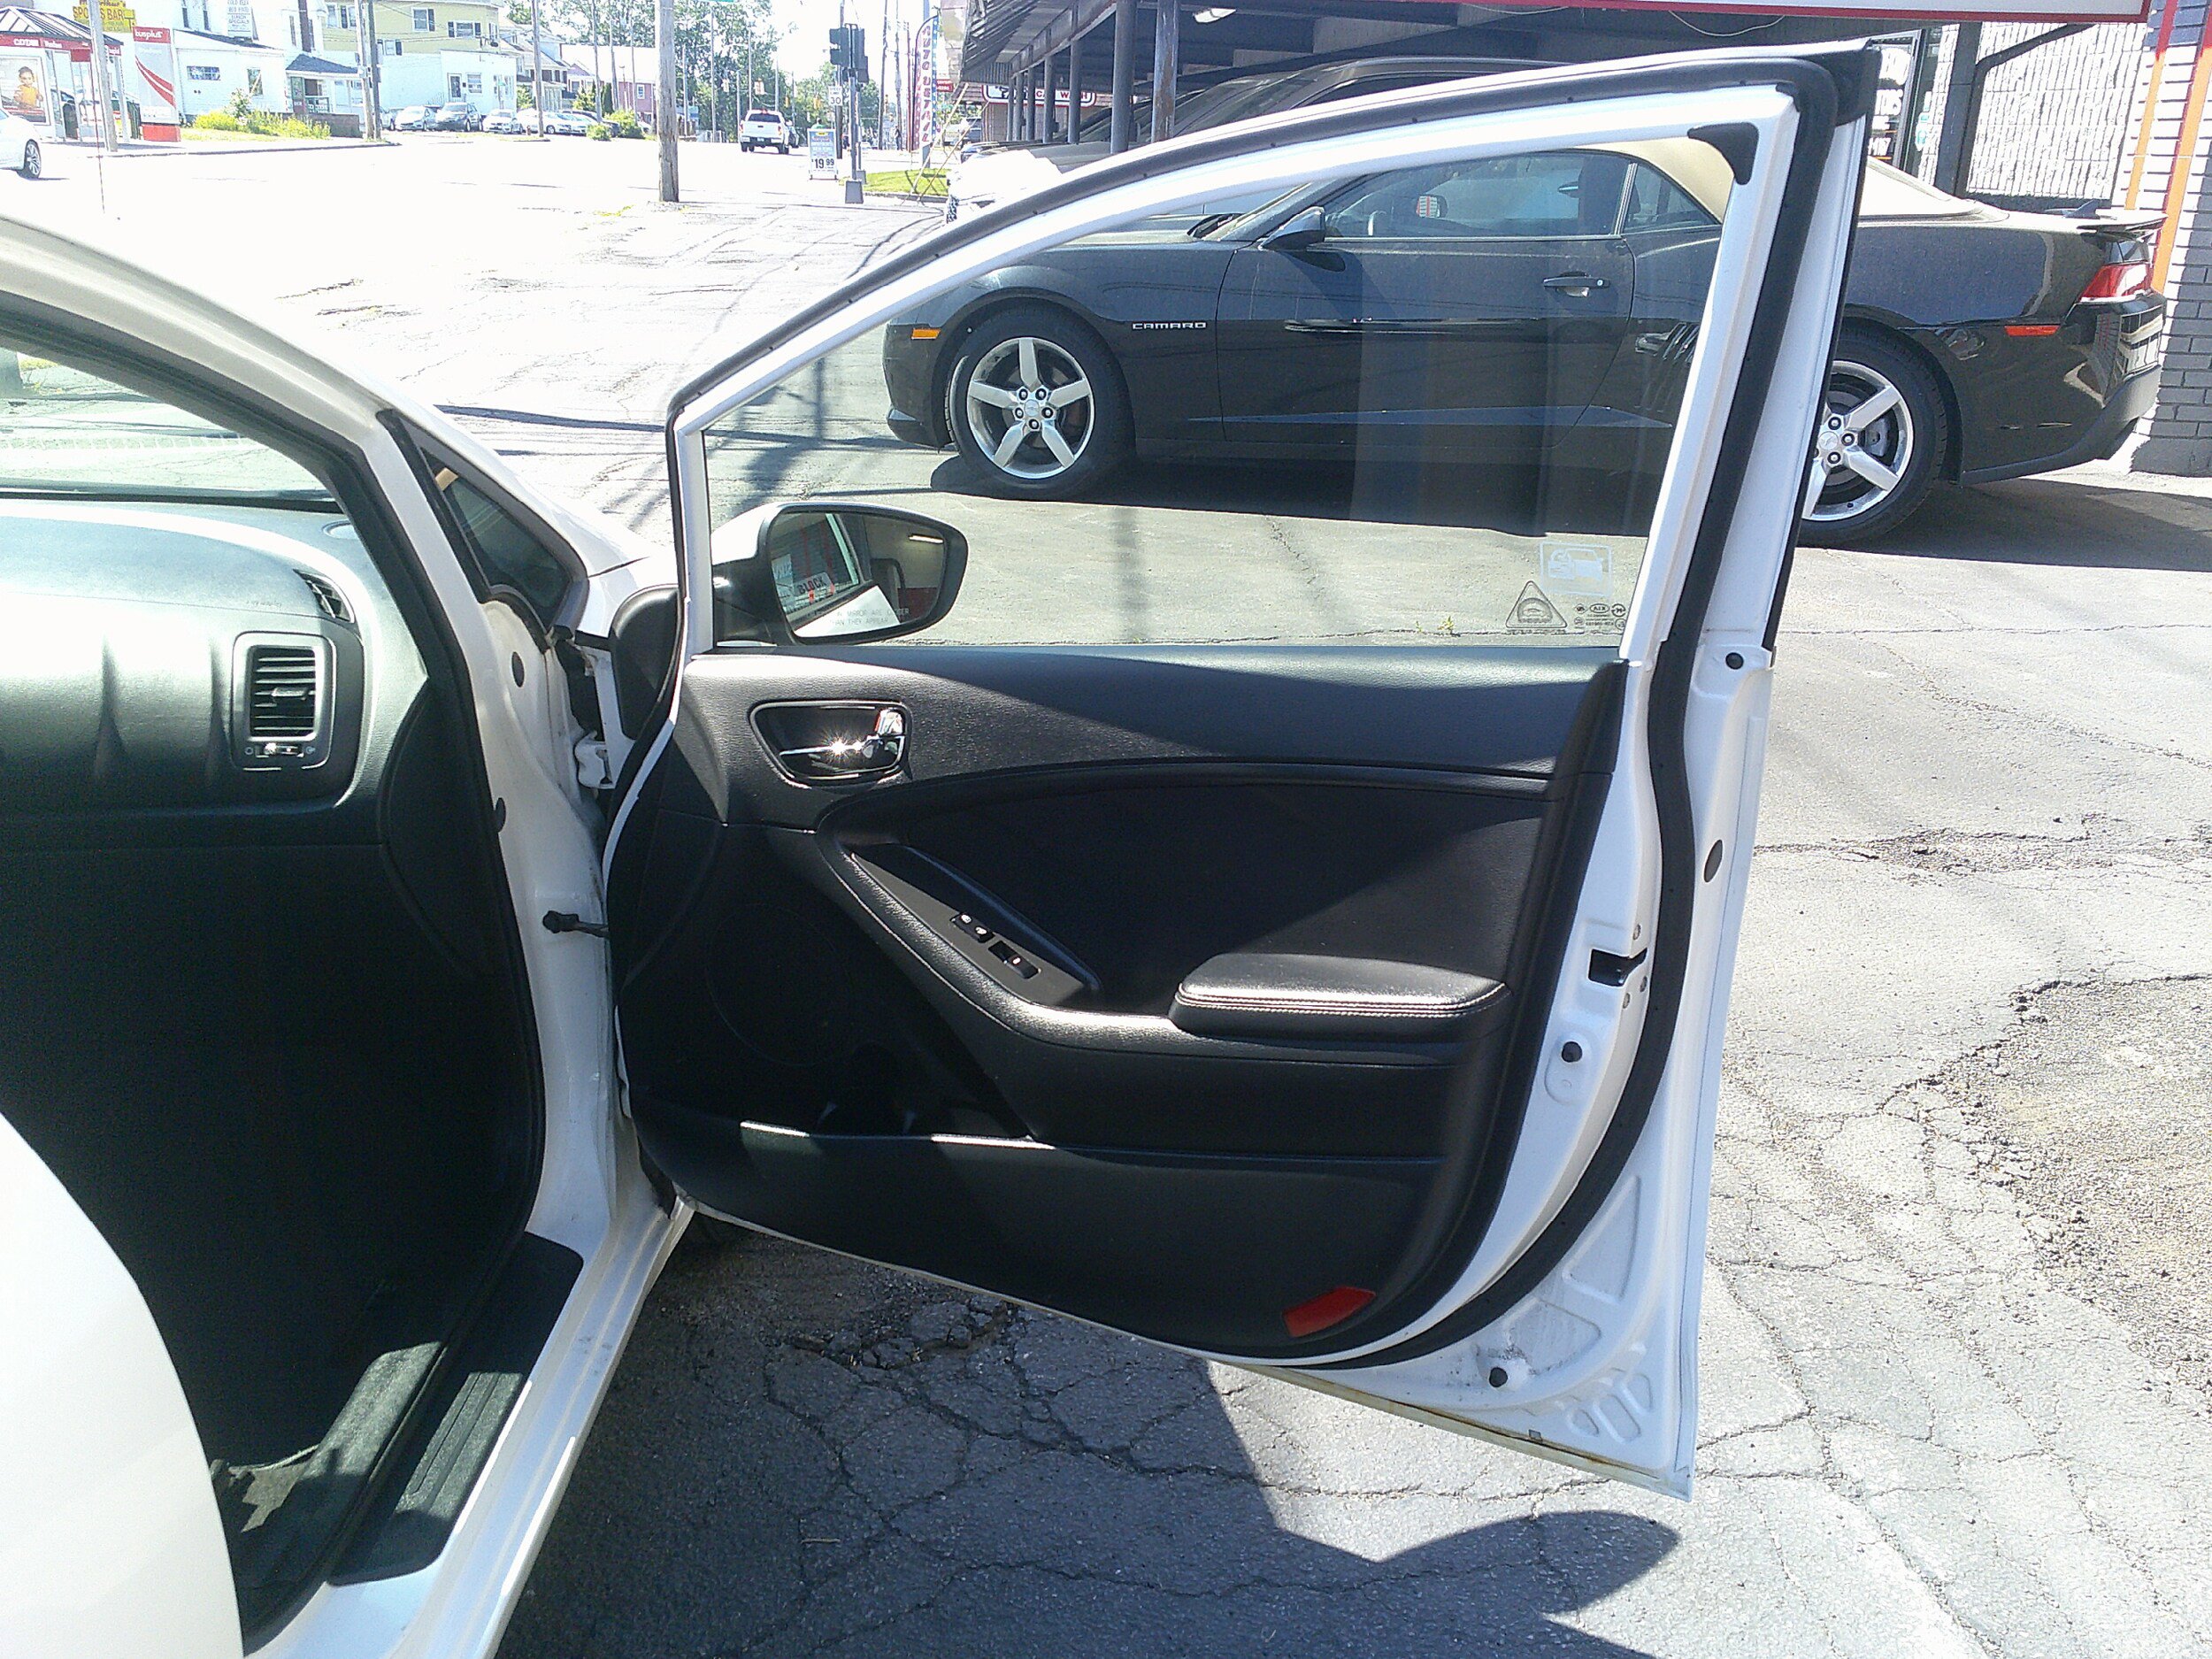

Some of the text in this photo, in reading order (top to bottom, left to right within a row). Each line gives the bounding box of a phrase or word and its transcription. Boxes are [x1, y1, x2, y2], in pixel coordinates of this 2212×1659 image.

[73, 5, 125, 20] SPOS BAR
[796, 576, 826, 595] BLOCK
